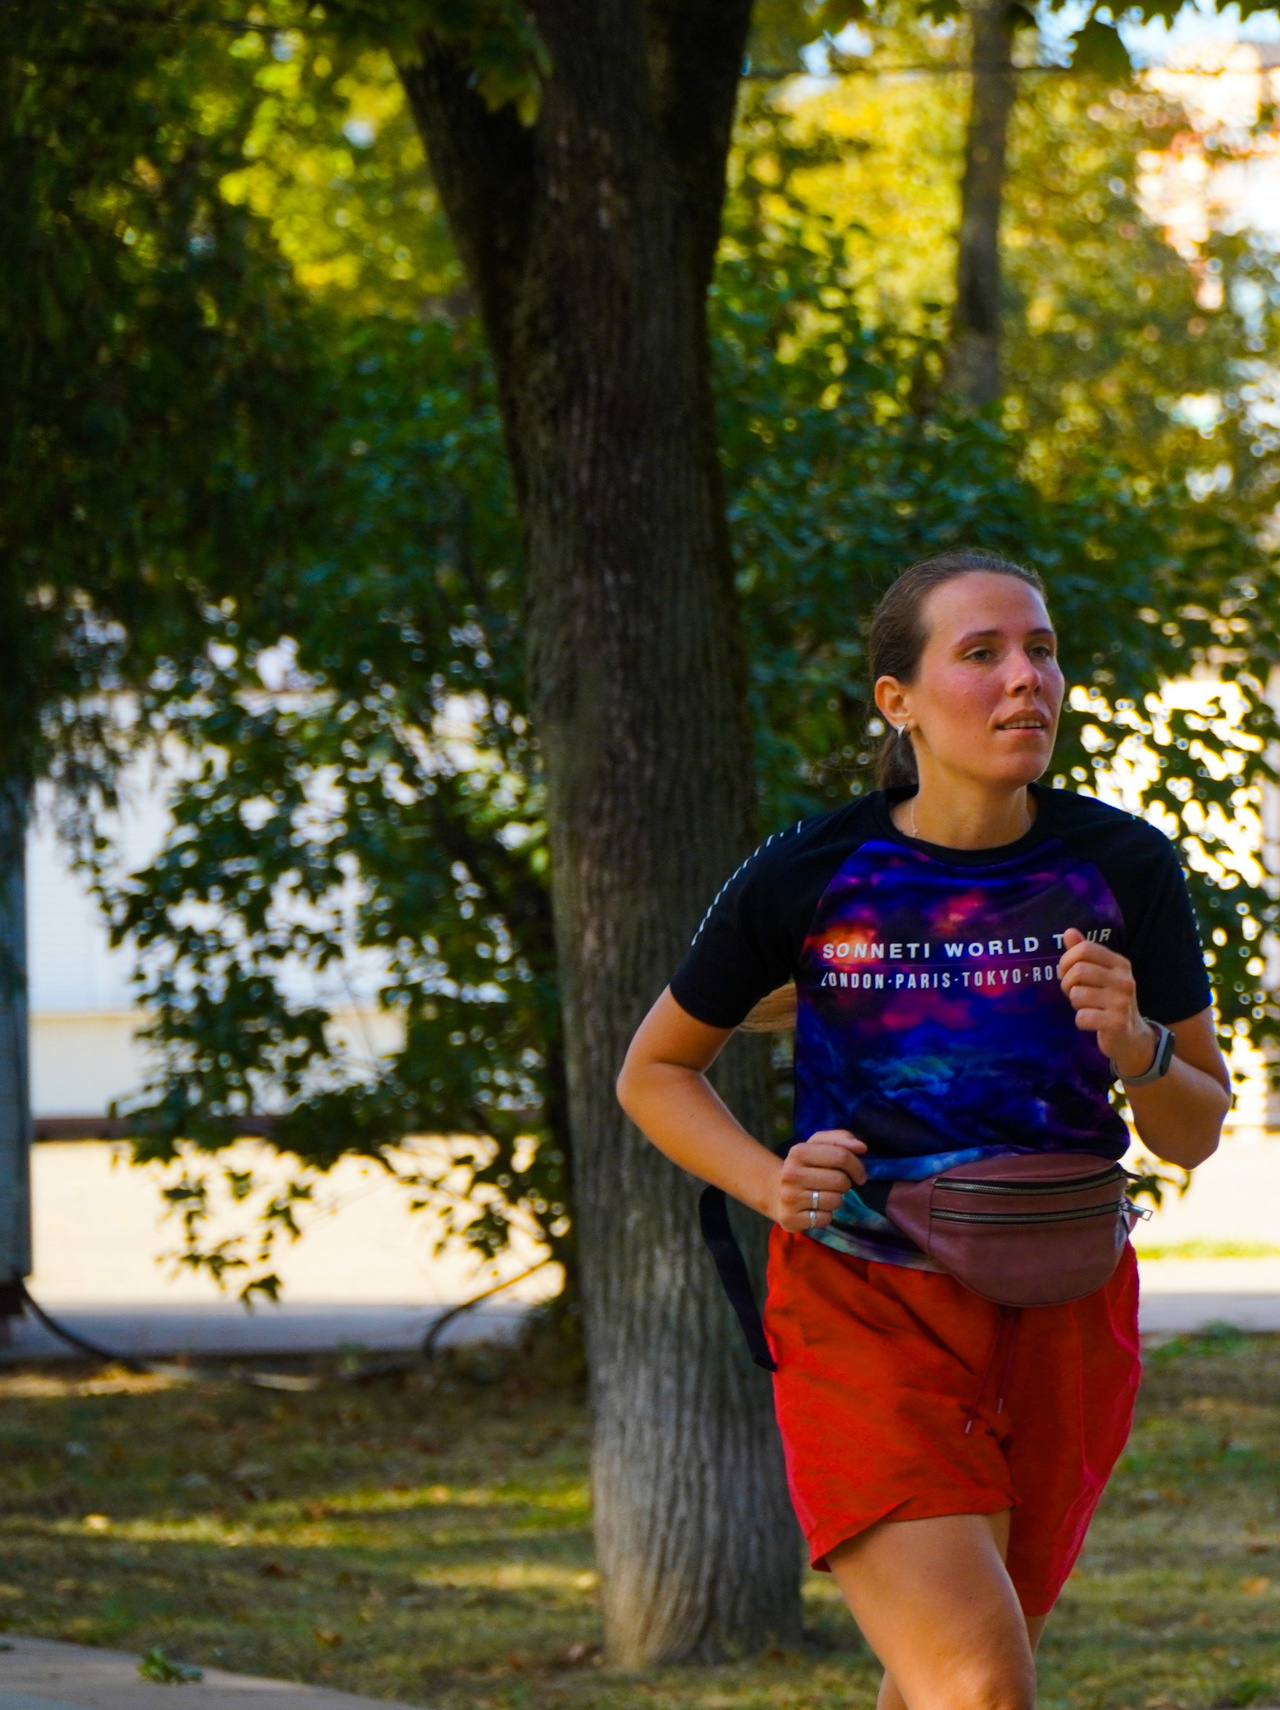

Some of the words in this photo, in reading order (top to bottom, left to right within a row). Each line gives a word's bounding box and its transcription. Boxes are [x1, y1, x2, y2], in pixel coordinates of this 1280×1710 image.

[822, 942, 930, 959] SONNETI
[944, 936, 1039, 958] WORLD
[1052, 928, 1112, 949] TUR
[895, 973, 951, 989] PARIS
[962, 968, 1021, 987] TOKYO
[1033, 965, 1061, 982] RO
